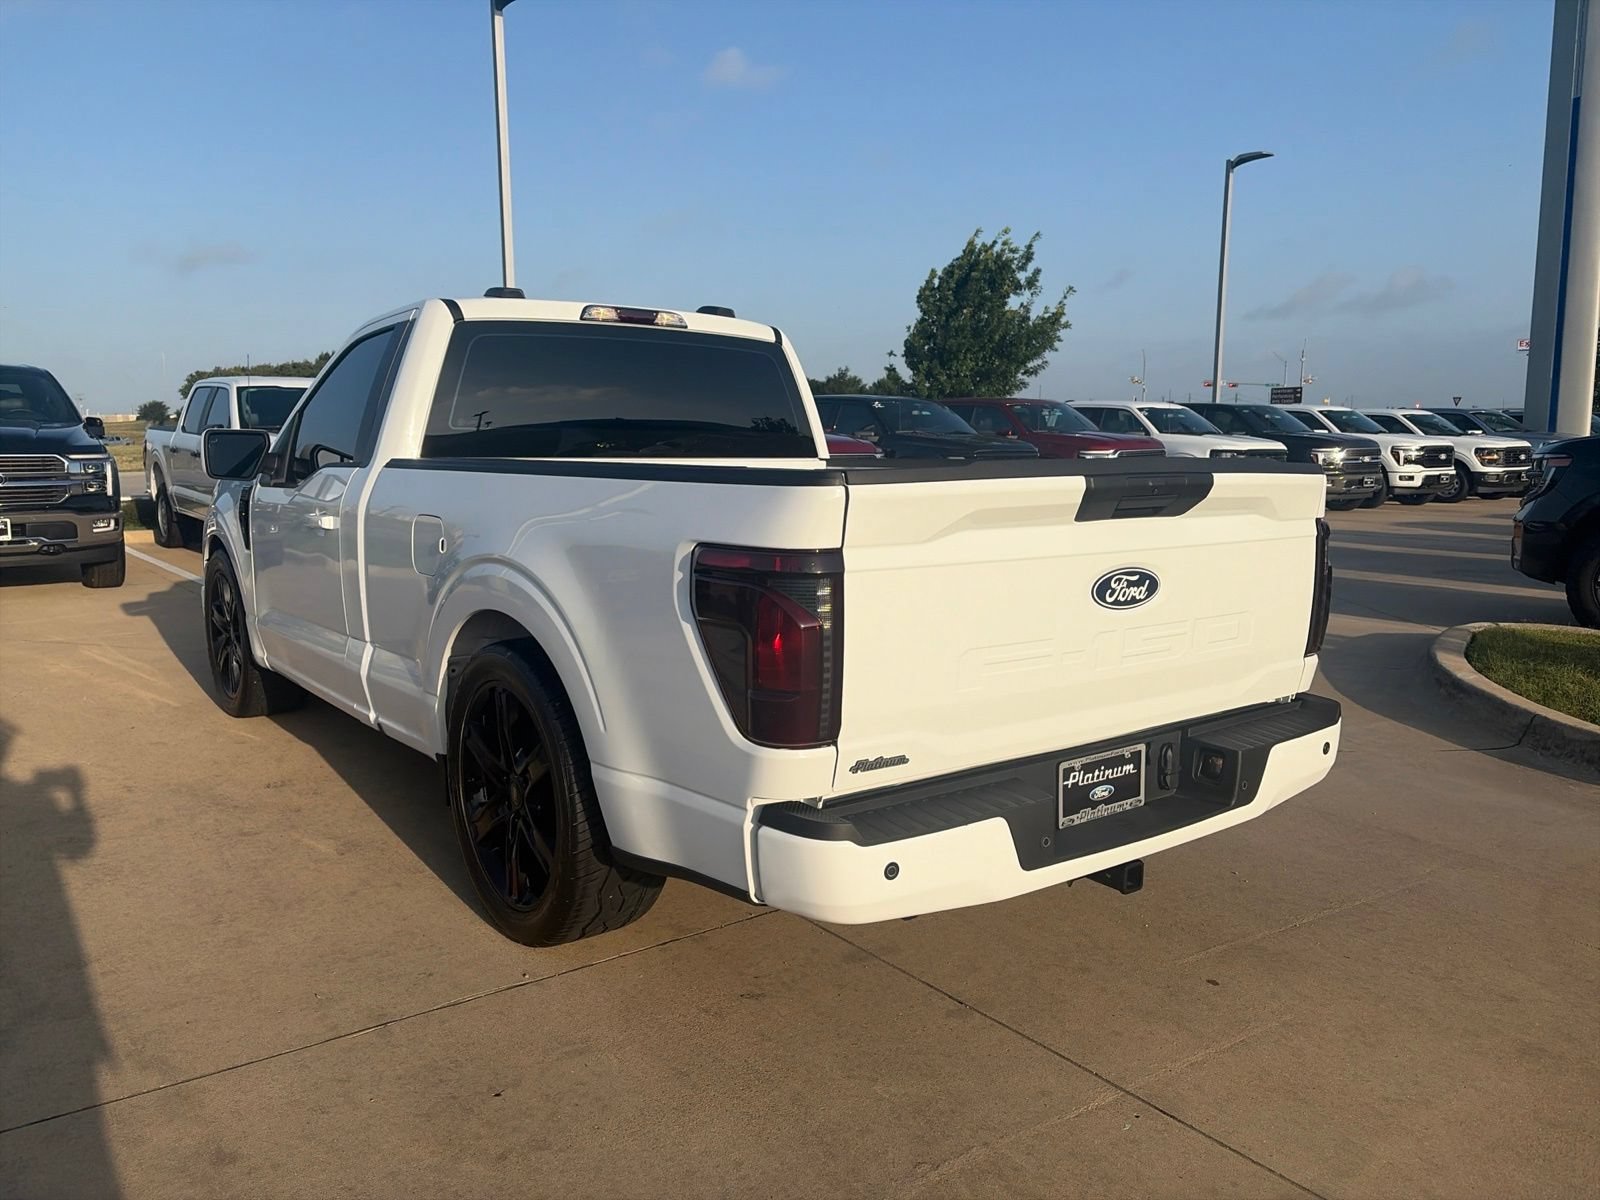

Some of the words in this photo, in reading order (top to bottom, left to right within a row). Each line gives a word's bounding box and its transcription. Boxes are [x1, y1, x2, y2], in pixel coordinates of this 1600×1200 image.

[1105, 574, 1150, 603] Ford
[849, 754, 910, 774] Platinum
[1063, 763, 1137, 788] Platinum
[1094, 786, 1111, 799] Ford
[1079, 804, 1127, 822] Platinum
